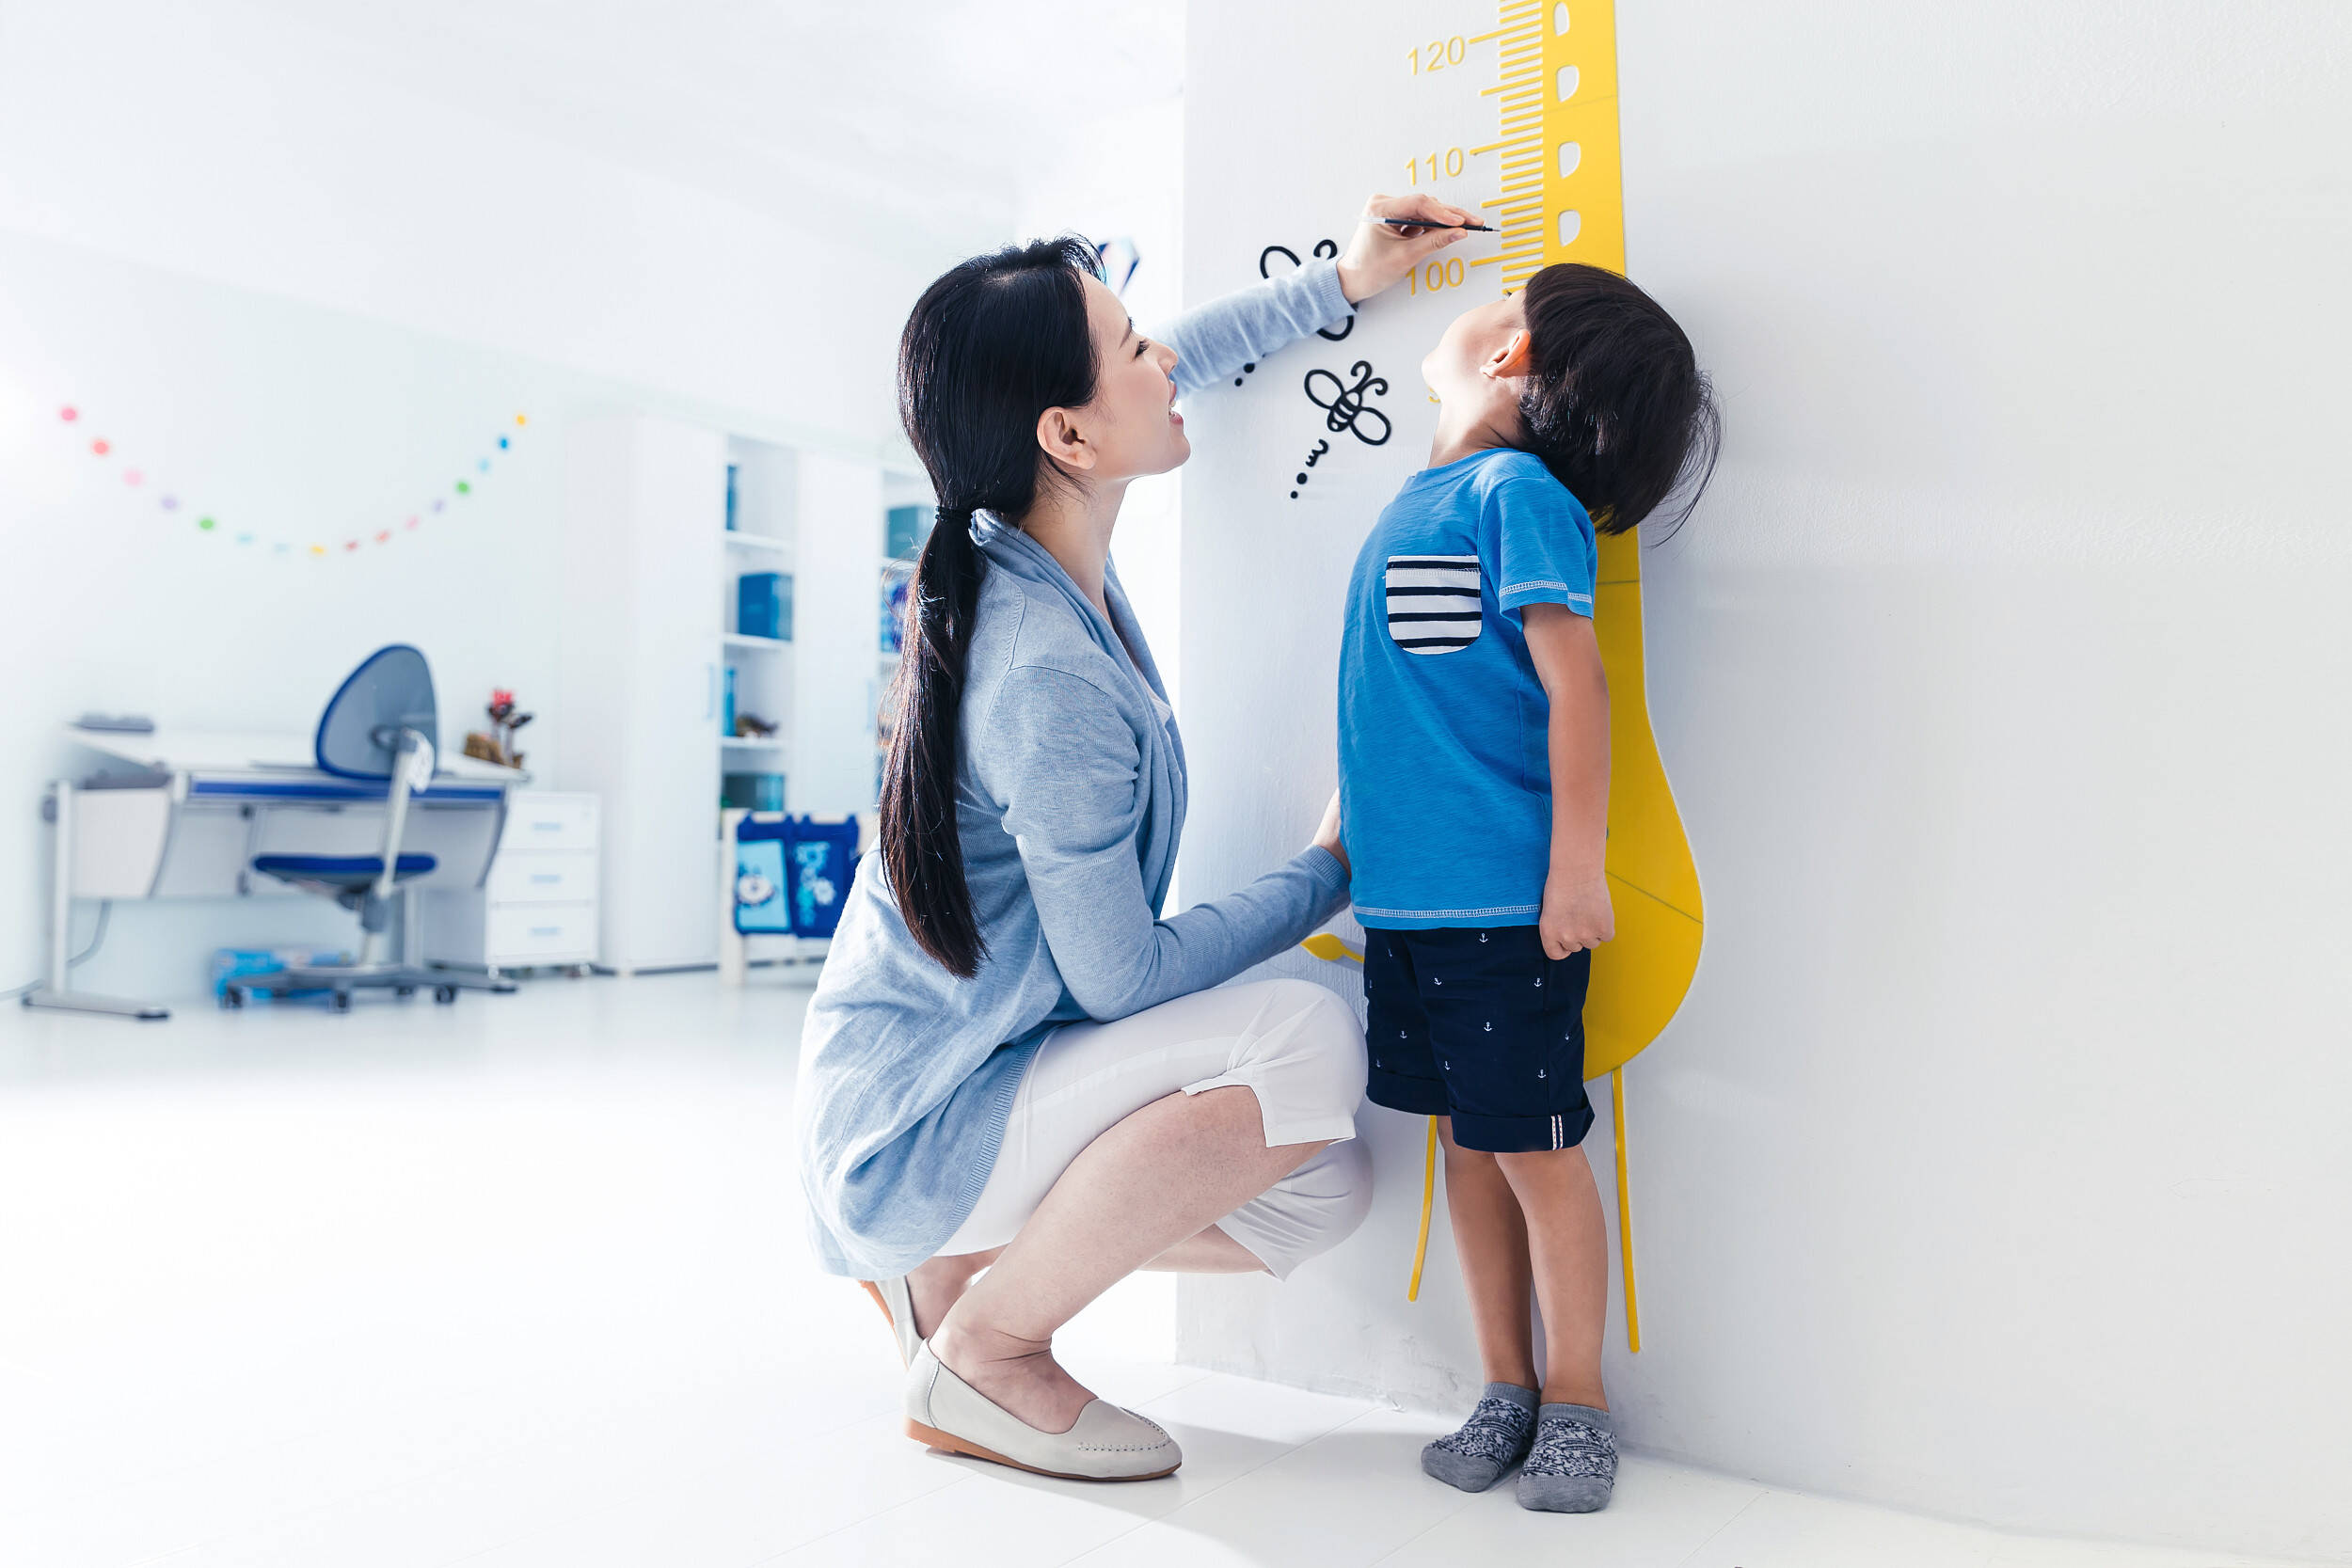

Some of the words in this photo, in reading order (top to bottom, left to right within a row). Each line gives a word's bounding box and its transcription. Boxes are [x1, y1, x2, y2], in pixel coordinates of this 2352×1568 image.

[1406, 36, 1465, 75] 120
[1405, 147, 1464, 186] 110
[1405, 257, 1465, 296] 100
